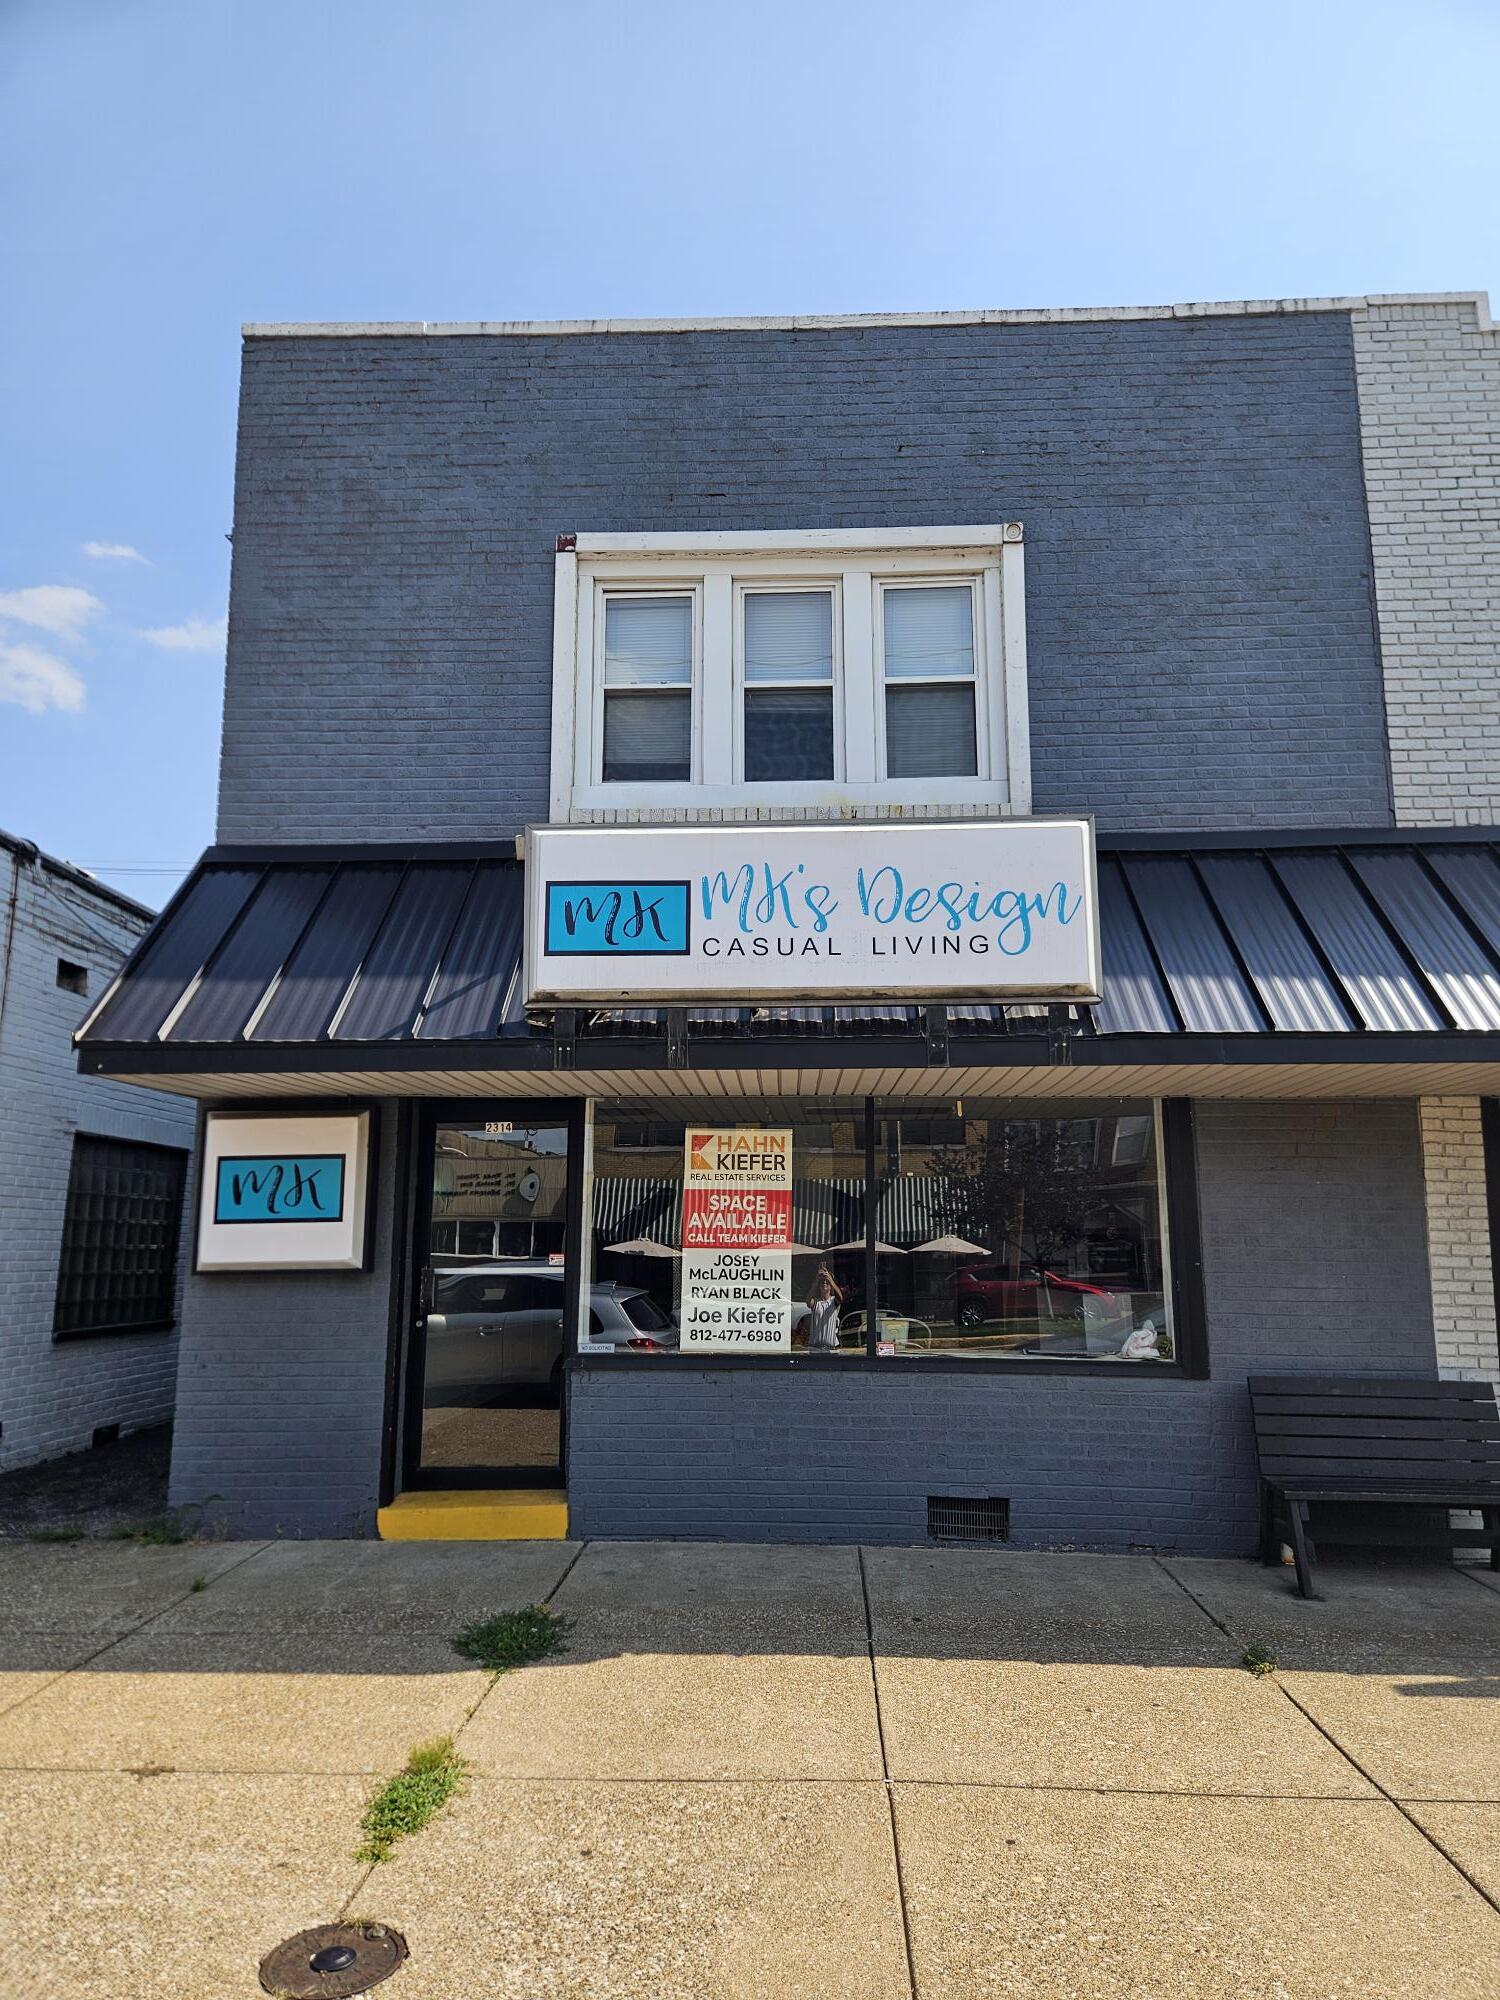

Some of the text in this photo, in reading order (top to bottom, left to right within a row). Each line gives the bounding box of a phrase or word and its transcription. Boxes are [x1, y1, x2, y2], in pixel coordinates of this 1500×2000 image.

[701, 863, 1082, 955] MK's Design
[565, 890, 670, 945] MK
[702, 935, 990, 956] CASUAL LIVING
[486, 1122, 512, 1133] 2314
[717, 1135, 785, 1152] HAHN
[717, 1154, 786, 1171] KIEFER
[746, 1174, 786, 1182] SERVICES
[232, 1163, 325, 1214] MK
[709, 1195, 766, 1211] SPACE
[688, 1213, 787, 1229] AVAILABLE
[687, 1233, 787, 1244] CALL TEAM KIEFER
[714, 1255, 760, 1267] JOSEY
[689, 1269, 784, 1281] McLAUGHLIN
[691, 1287, 781, 1300] RYAN BLACK
[687, 1307, 784, 1324] Joe Kiefer
[689, 1329, 782, 1342] 812-477-6980
